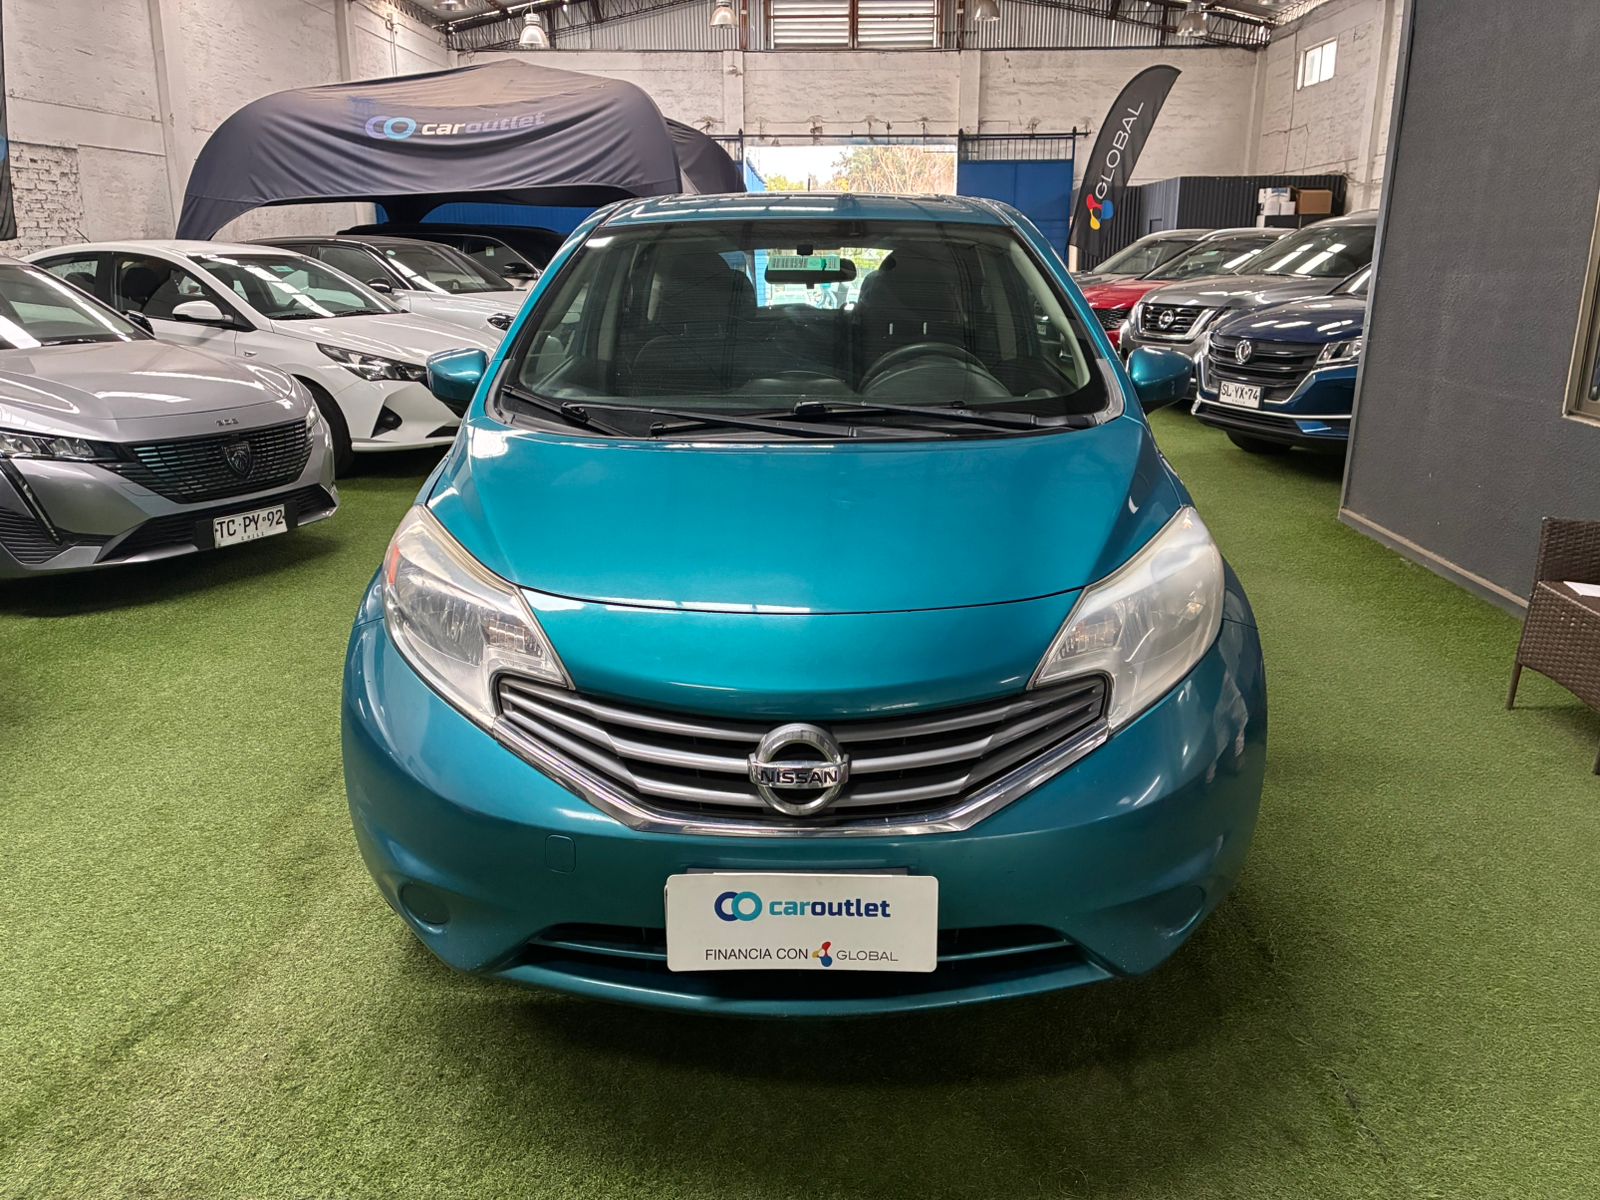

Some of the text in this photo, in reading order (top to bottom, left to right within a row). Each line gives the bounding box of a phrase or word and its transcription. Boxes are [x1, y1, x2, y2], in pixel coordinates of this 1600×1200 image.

[421, 112, 545, 136] caroutlet
[1095, 102, 1144, 199] GLOBAL
[760, 769, 838, 785] NISSAN
[769, 898, 891, 918] caroutlet
[705, 948, 899, 962] FINANCIA CON GLOBAL
